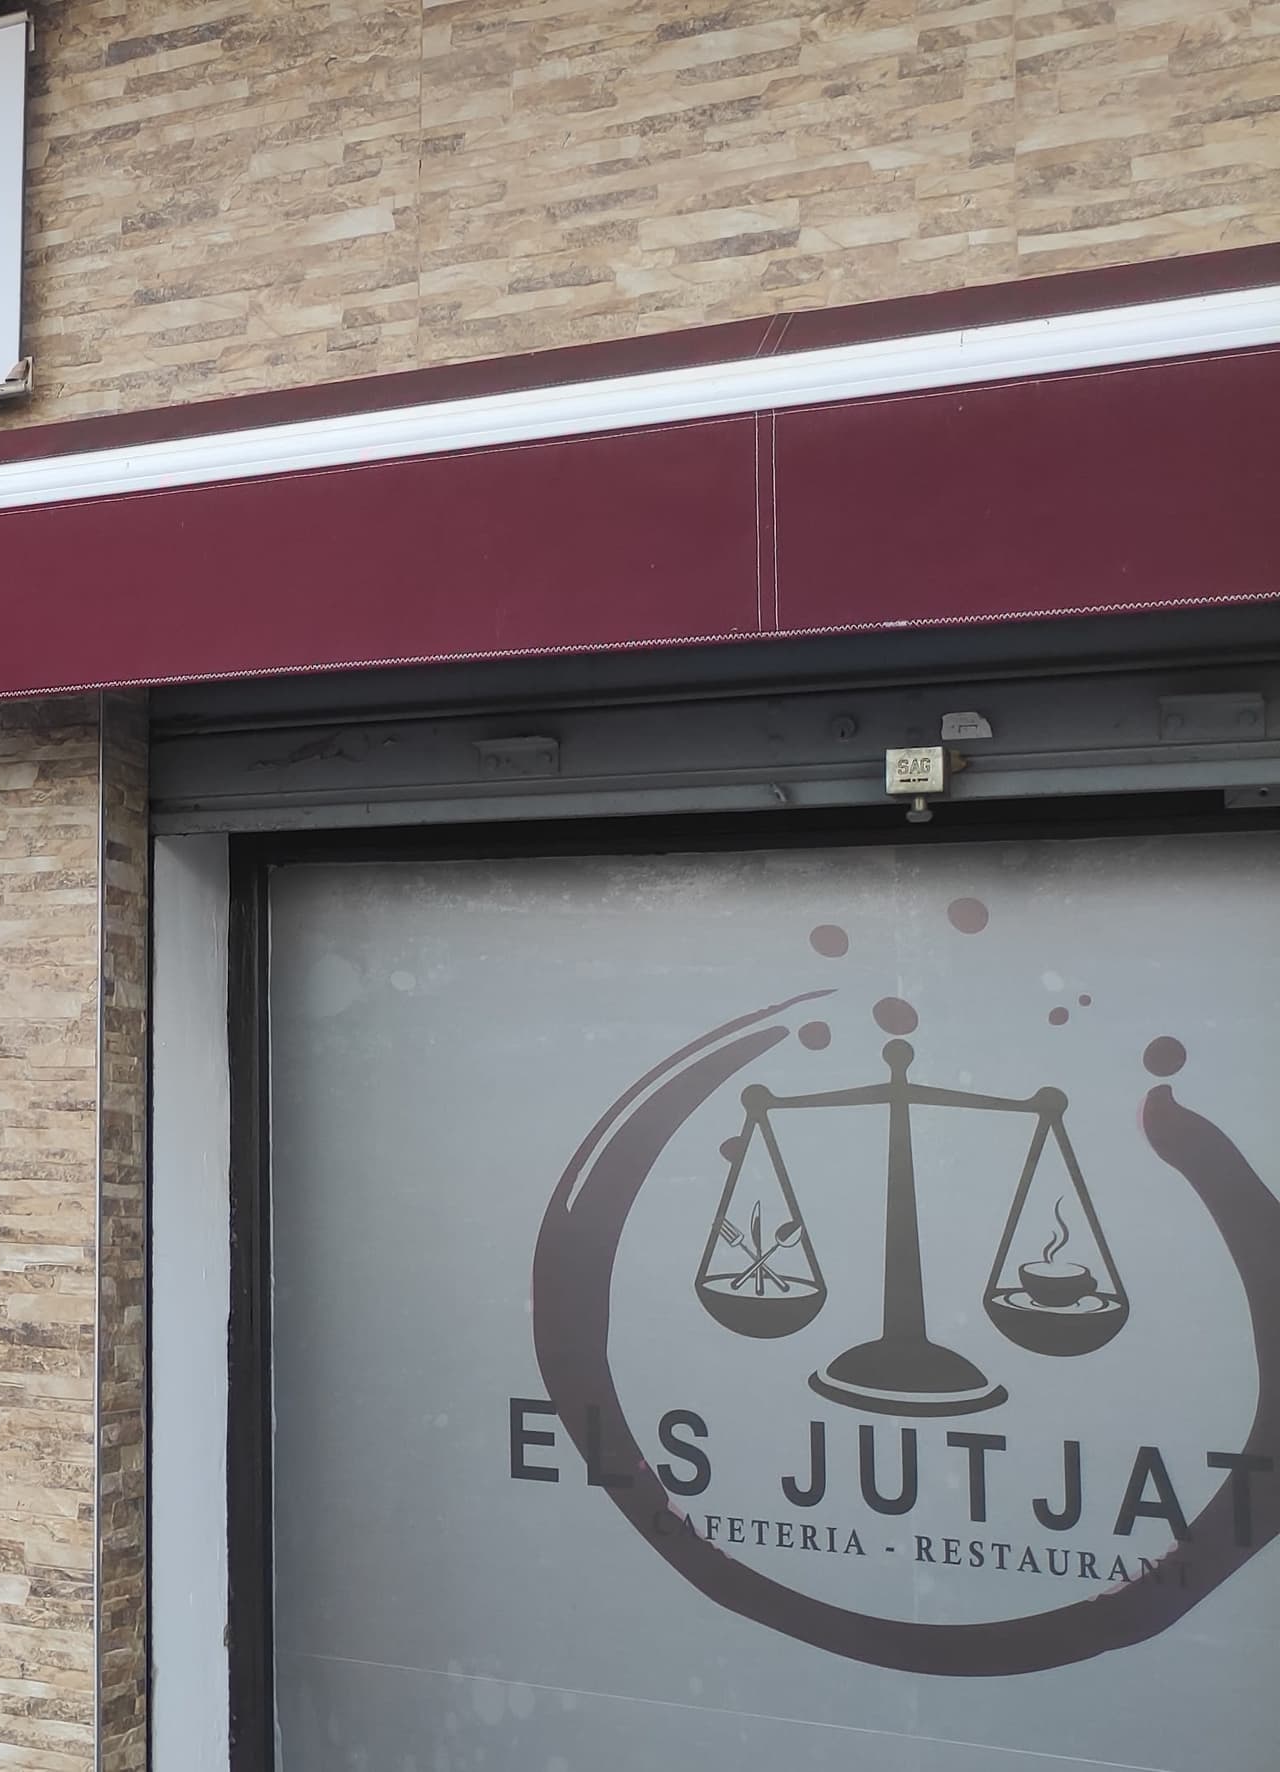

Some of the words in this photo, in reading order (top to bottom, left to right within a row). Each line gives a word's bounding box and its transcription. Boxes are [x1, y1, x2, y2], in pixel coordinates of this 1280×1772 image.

[897, 757, 931, 775] SAG
[509, 1397, 712, 1497] ELS
[652, 1508, 866, 1556] CAFETERIA
[914, 1536, 1188, 1588] RESTAURANT
